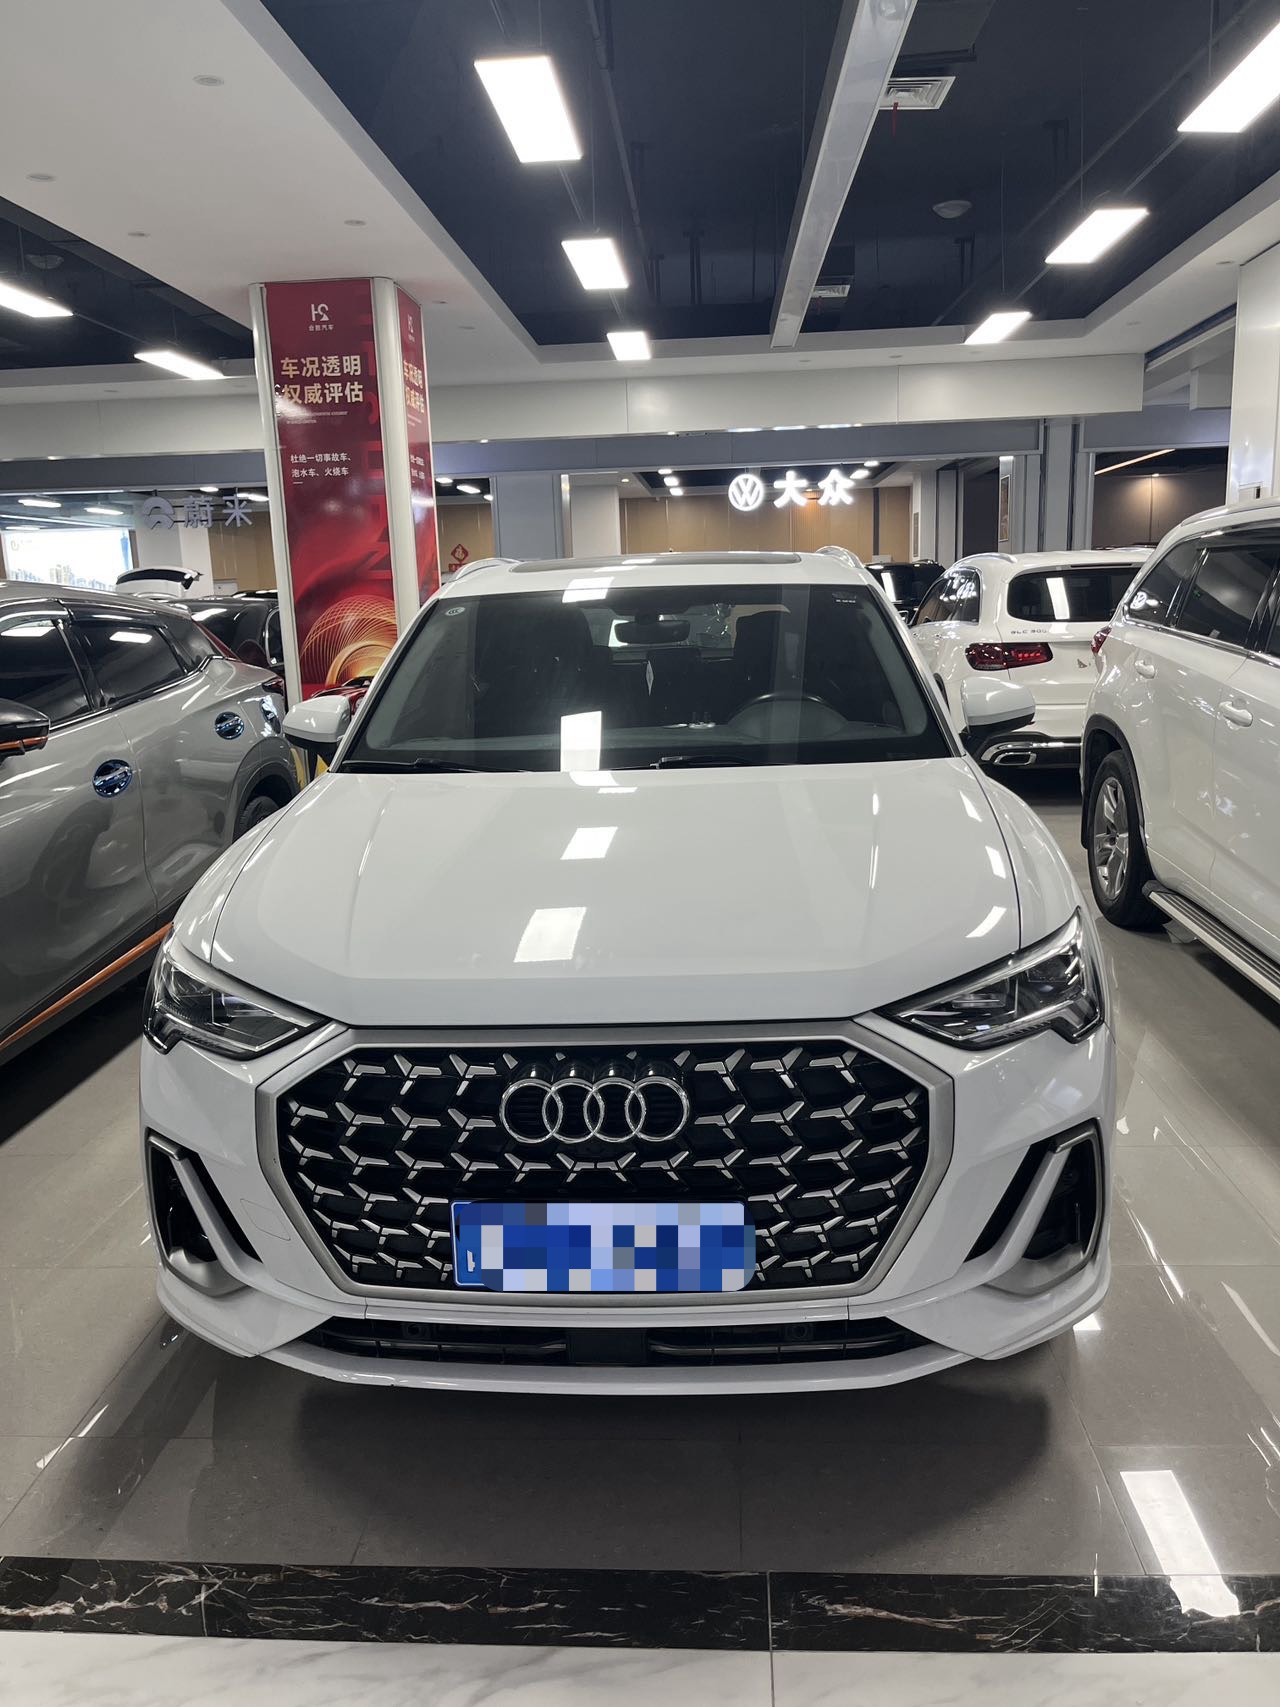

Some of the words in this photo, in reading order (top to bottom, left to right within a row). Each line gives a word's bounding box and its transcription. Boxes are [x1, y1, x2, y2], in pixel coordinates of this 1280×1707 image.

[280, 355, 361, 379] 车况透明
[282, 381, 364, 405] 权威评估
[773, 469, 855, 508] 大众
[183, 494, 253, 528] 蔚来
